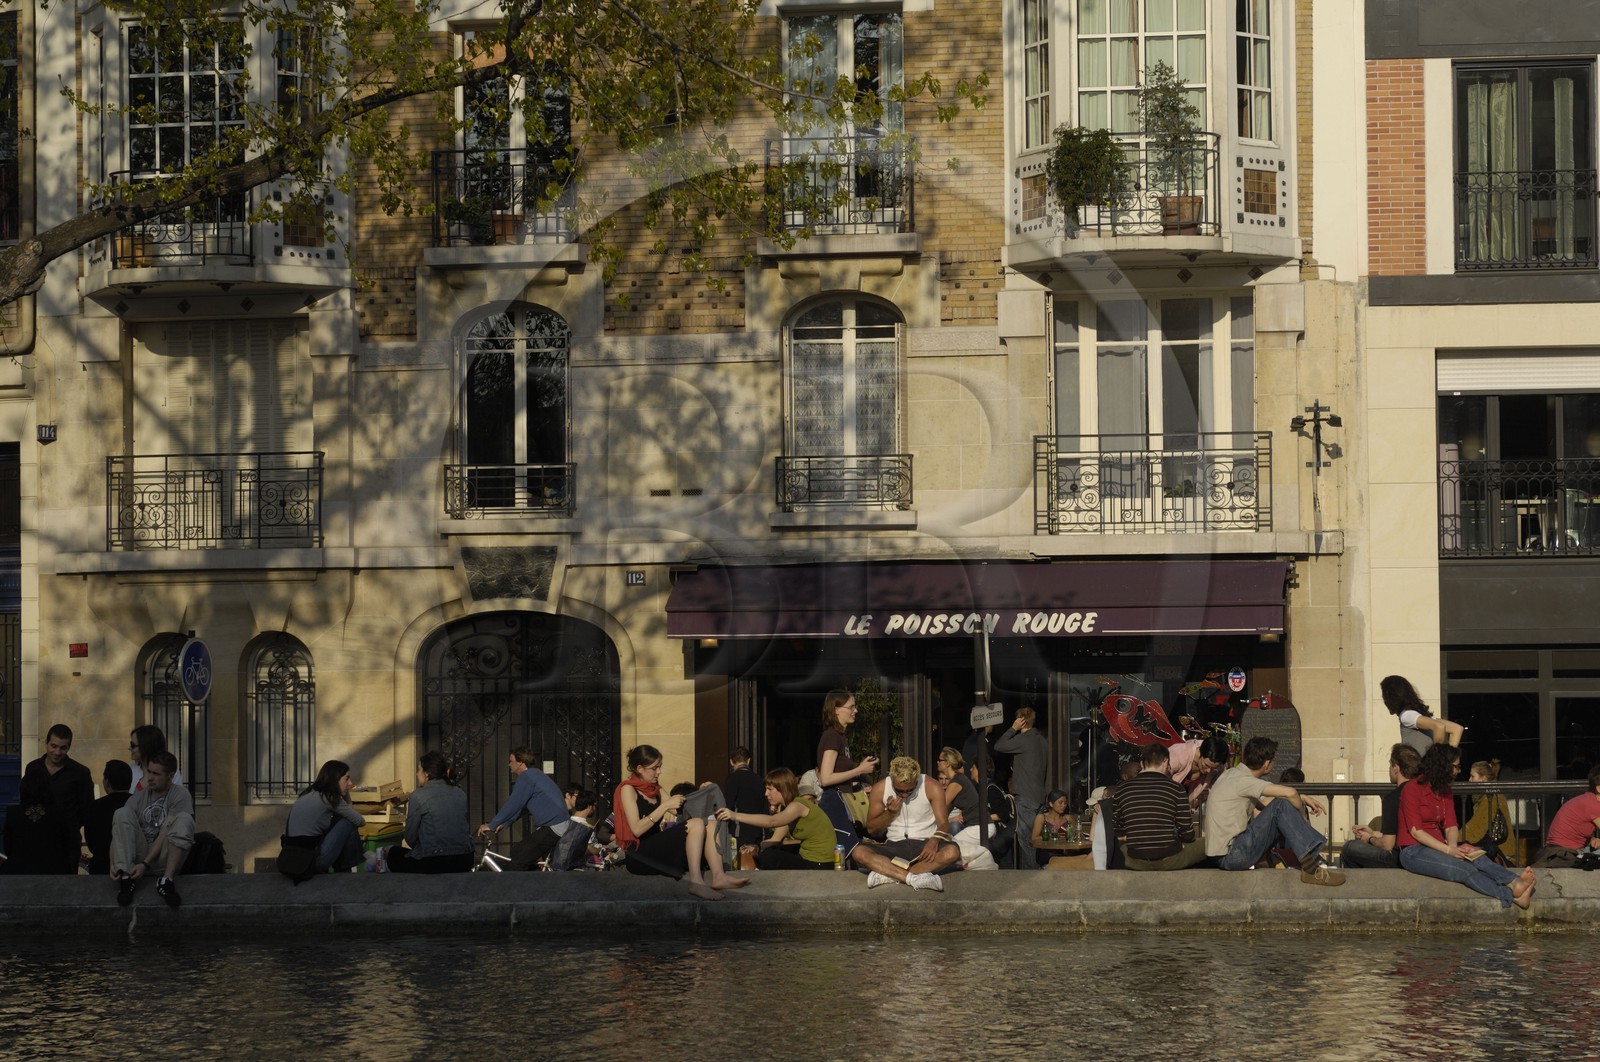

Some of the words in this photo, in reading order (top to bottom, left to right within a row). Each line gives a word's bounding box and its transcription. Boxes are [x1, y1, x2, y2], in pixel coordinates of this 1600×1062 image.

[41, 426, 55, 438] 114
[628, 572, 644, 584] 112
[844, 614, 872, 636] LE
[884, 613, 1001, 635] POISSON
[1011, 611, 1099, 634] ROUGE
